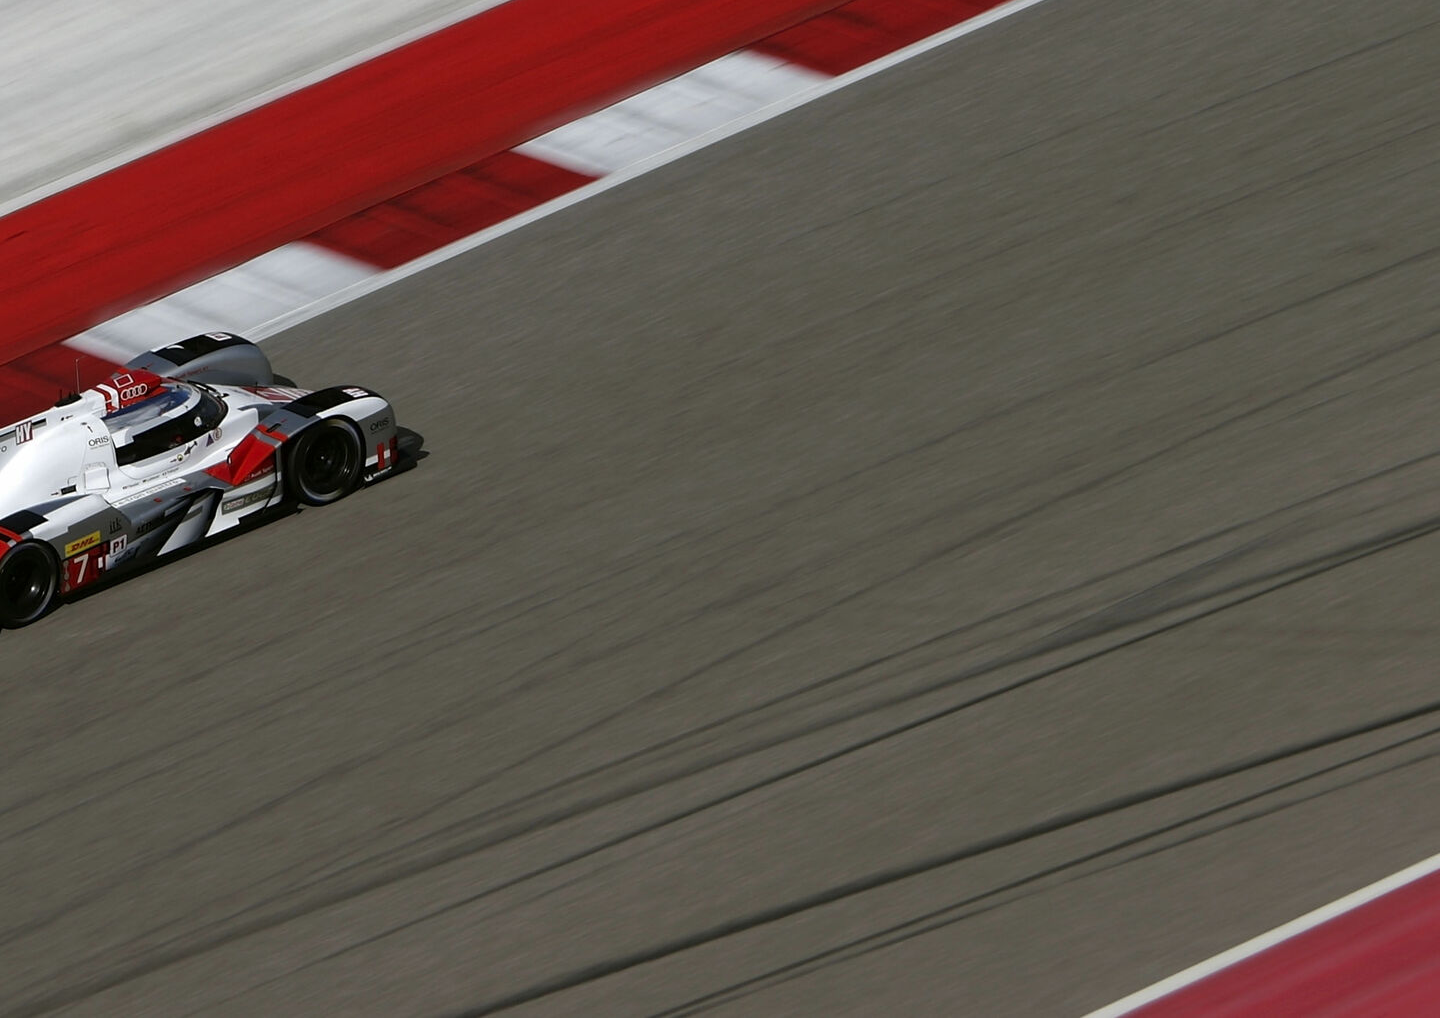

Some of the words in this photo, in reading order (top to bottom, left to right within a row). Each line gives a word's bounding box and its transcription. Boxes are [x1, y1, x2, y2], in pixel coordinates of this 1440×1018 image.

[15, 422, 33, 445] HY
[88, 436, 109, 447] ORIS
[71, 536, 95, 552] DHL
[113, 538, 125, 553] P1
[73, 553, 89, 584] 7
